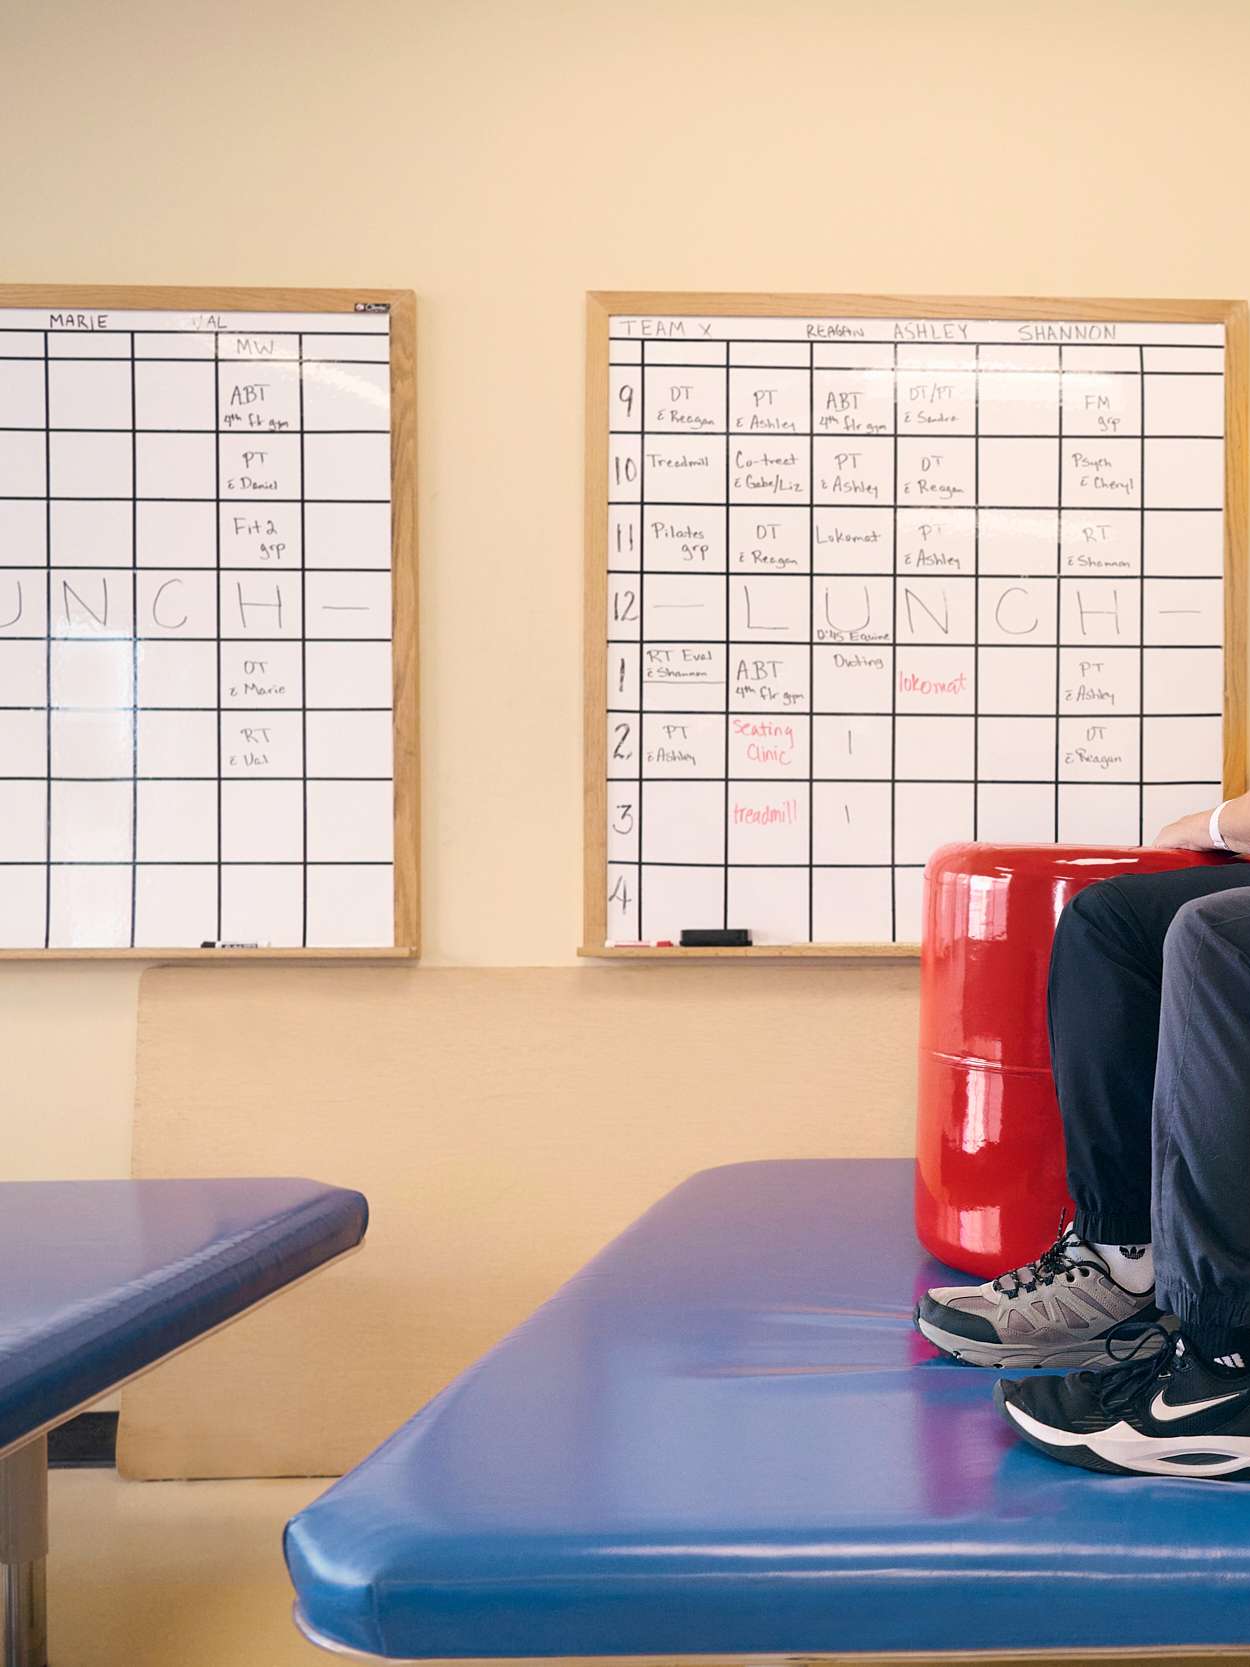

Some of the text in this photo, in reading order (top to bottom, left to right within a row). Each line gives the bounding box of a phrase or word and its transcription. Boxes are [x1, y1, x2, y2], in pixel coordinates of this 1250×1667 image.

[49, 314, 109, 331] MARIE
[619, 319, 712, 337] TEAM X
[806, 323, 865, 338] REAGAN
[893, 322, 969, 340] ASHLEY
[1018, 323, 1117, 342] SHANNON
[237, 338, 274, 355] MW
[230, 383, 271, 406] ABT
[619, 384, 634, 418] 9
[753, 389, 778, 408] PT
[826, 391, 864, 413] ABT
[1084, 394, 1111, 411] FM
[670, 409, 716, 430] Reagan
[750, 414, 796, 432] Ashley
[819, 415, 840, 430] 4th
[1098, 416, 1121, 432] grp
[241, 451, 269, 469] PT
[646, 453, 710, 468] Treadmill
[834, 452, 863, 471] PT
[1071, 452, 1112, 471] Psych
[615, 456, 638, 486] 10
[240, 476, 278, 491] Daniel
[832, 475, 879, 499] Ashley
[917, 479, 965, 500] Reagan
[233, 516, 278, 536] Fit 2
[651, 521, 705, 540] Pilates
[815, 525, 882, 545] Lokomat
[1082, 524, 1112, 543] RT
[260, 543, 286, 561] grp
[681, 543, 710, 561] grp
[751, 550, 798, 569] Reagan
[916, 548, 961, 570] Ashley
[1077, 554, 1131, 569] Shannon
[614, 590, 640, 622] 12
[646, 648, 713, 663] RT Eval
[736, 658, 785, 681] ABT
[1079, 661, 1105, 678] PT
[244, 682, 286, 696] Marie
[735, 685, 757, 699] 4th
[899, 671, 967, 695] lokomat
[1076, 685, 1116, 706] Ashley
[240, 727, 272, 744] RT
[612, 722, 633, 760] 2
[662, 724, 689, 740] PT
[733, 719, 795, 750] Seating
[244, 752, 269, 767] Val
[656, 747, 697, 767] Ashley
[746, 743, 793, 766] Clinic
[1075, 747, 1122, 769] Reagan
[612, 804, 634, 835] 3
[733, 799, 797, 825] treadmill
[608, 875, 632, 915] 4
